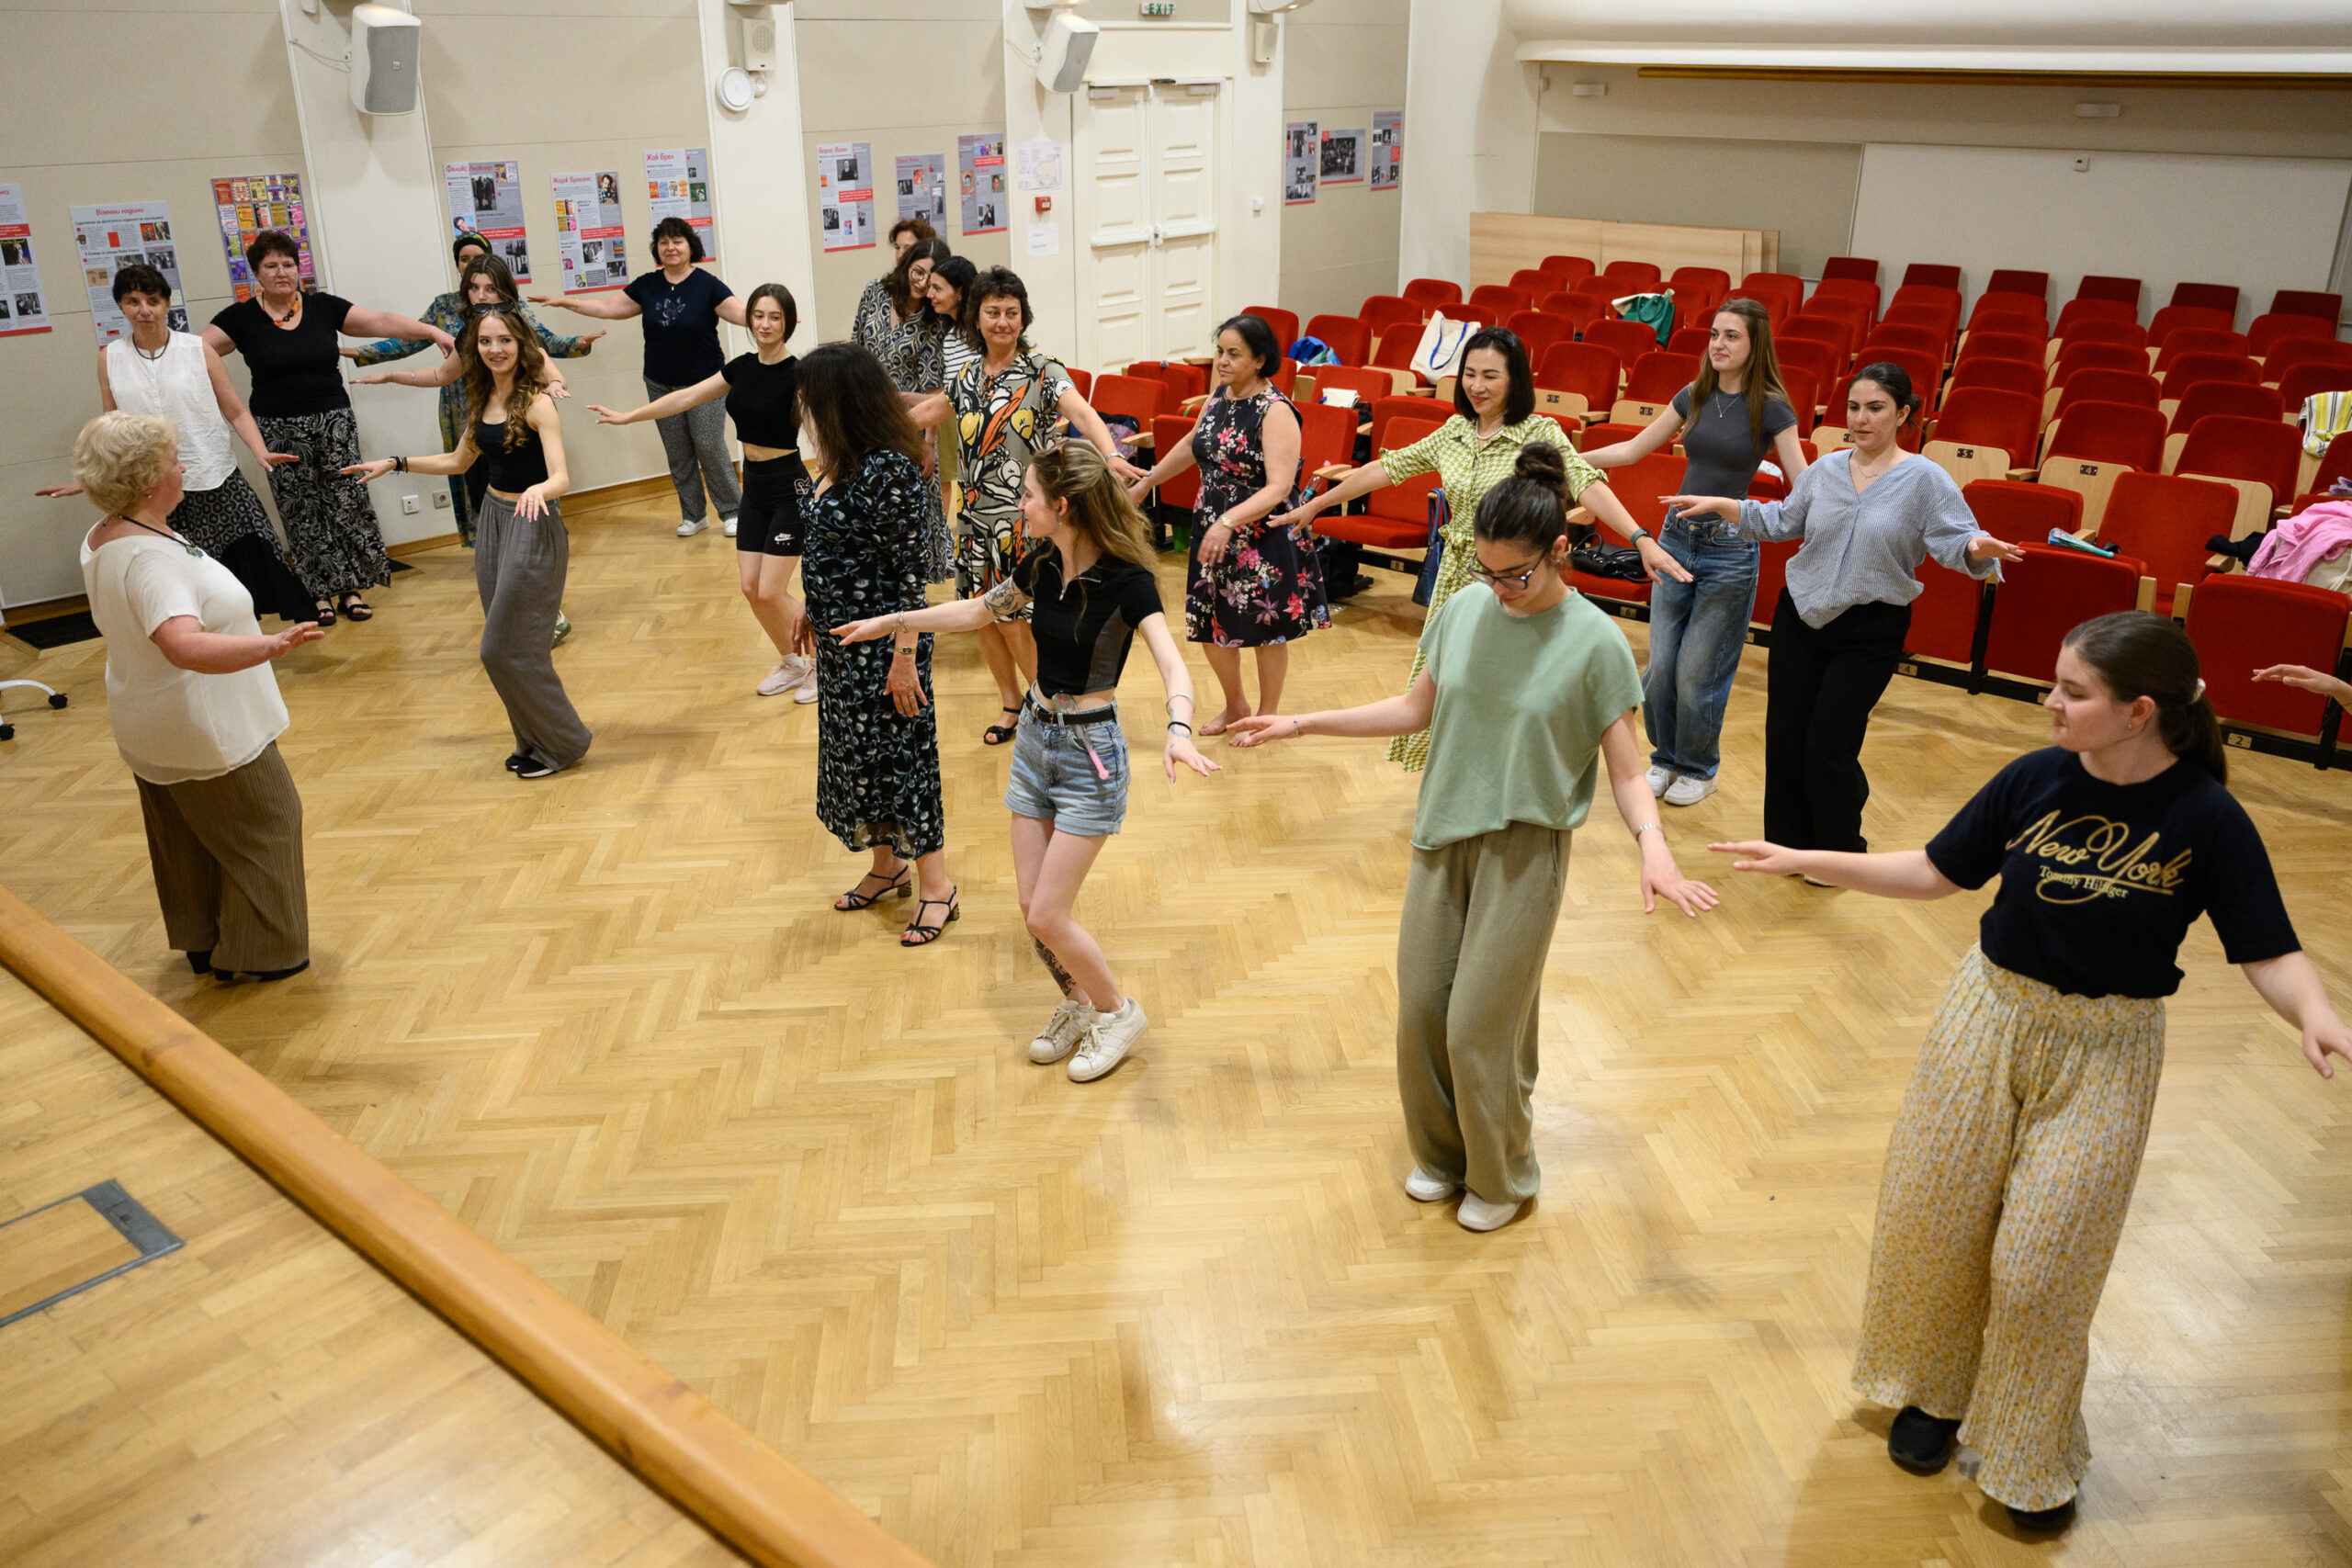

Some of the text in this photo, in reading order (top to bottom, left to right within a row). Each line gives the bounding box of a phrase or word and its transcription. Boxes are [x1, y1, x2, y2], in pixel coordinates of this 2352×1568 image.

[1148, 3, 1174, 15] EXIT
[2235, 736, 2244, 745] 2
[2006, 809, 2192, 889] New York
[2040, 864, 2129, 898] Tommy Hilfiger
